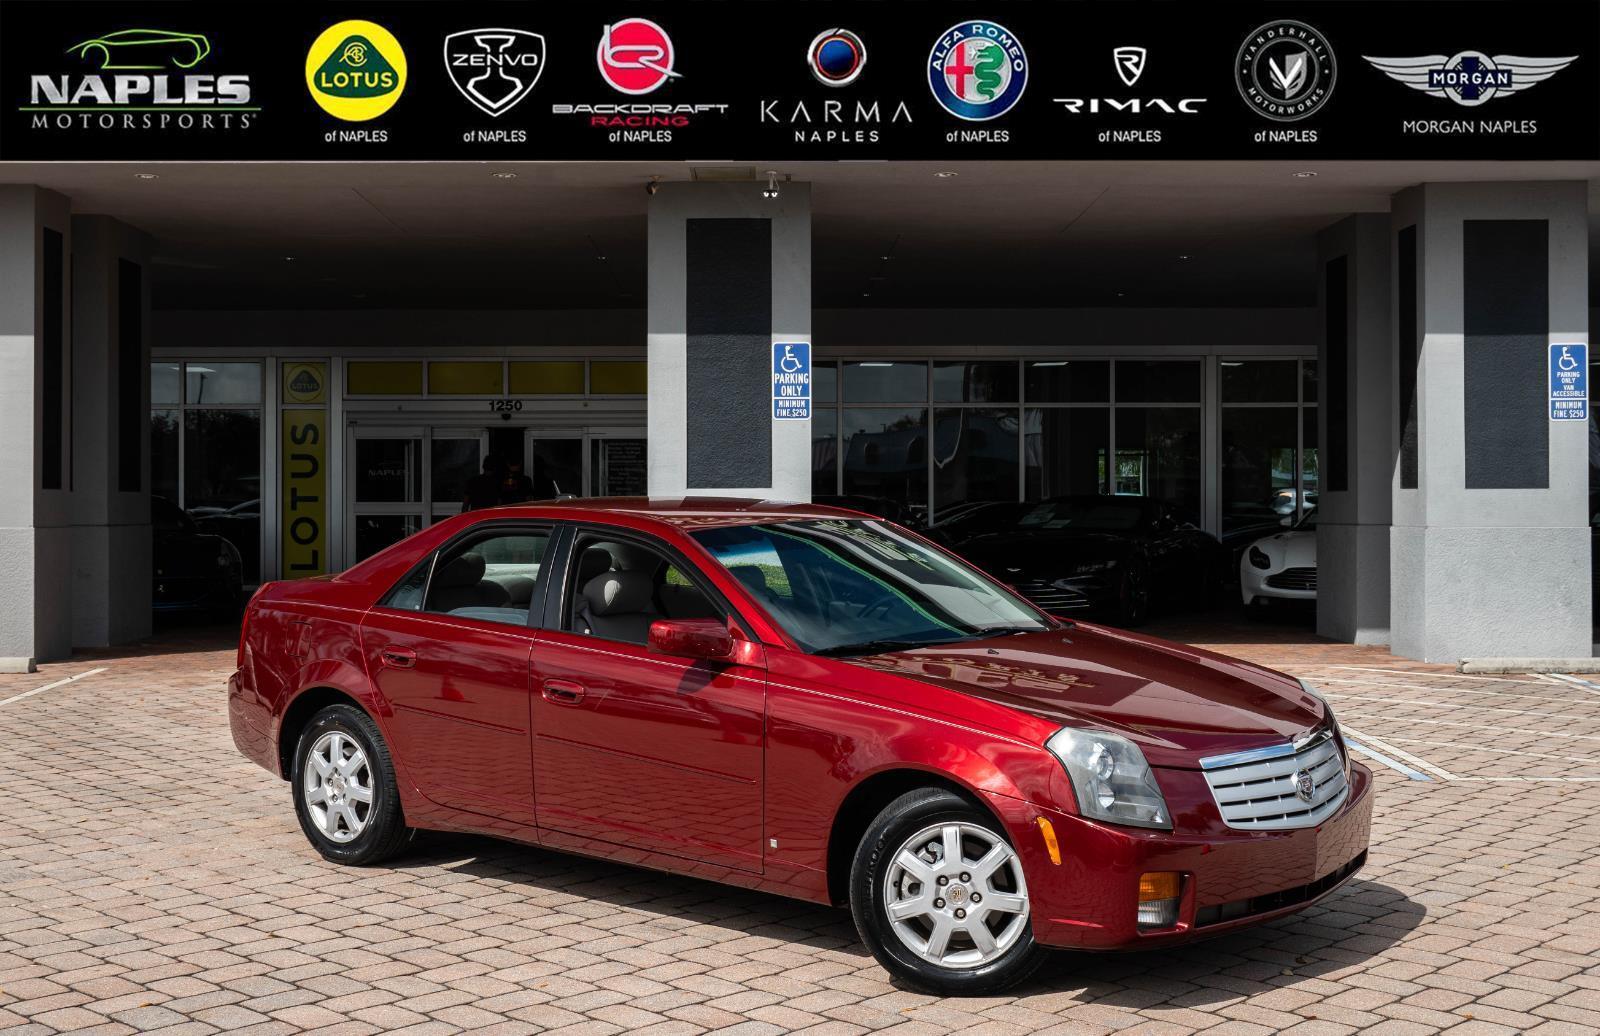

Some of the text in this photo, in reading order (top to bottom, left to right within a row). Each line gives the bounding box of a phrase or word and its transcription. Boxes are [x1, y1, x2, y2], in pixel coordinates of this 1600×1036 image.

[774, 373, 809, 384] PARKING
[781, 385, 802, 396] ONLY
[489, 400, 523, 412] 1250
[778, 400, 805, 408] MINIMUM
[1555, 401, 1582, 410] MINIMUM
[776, 408, 807, 417] FINE $250
[1553, 410, 1584, 418] FINE $250
[290, 423, 320, 571] LOTUS
